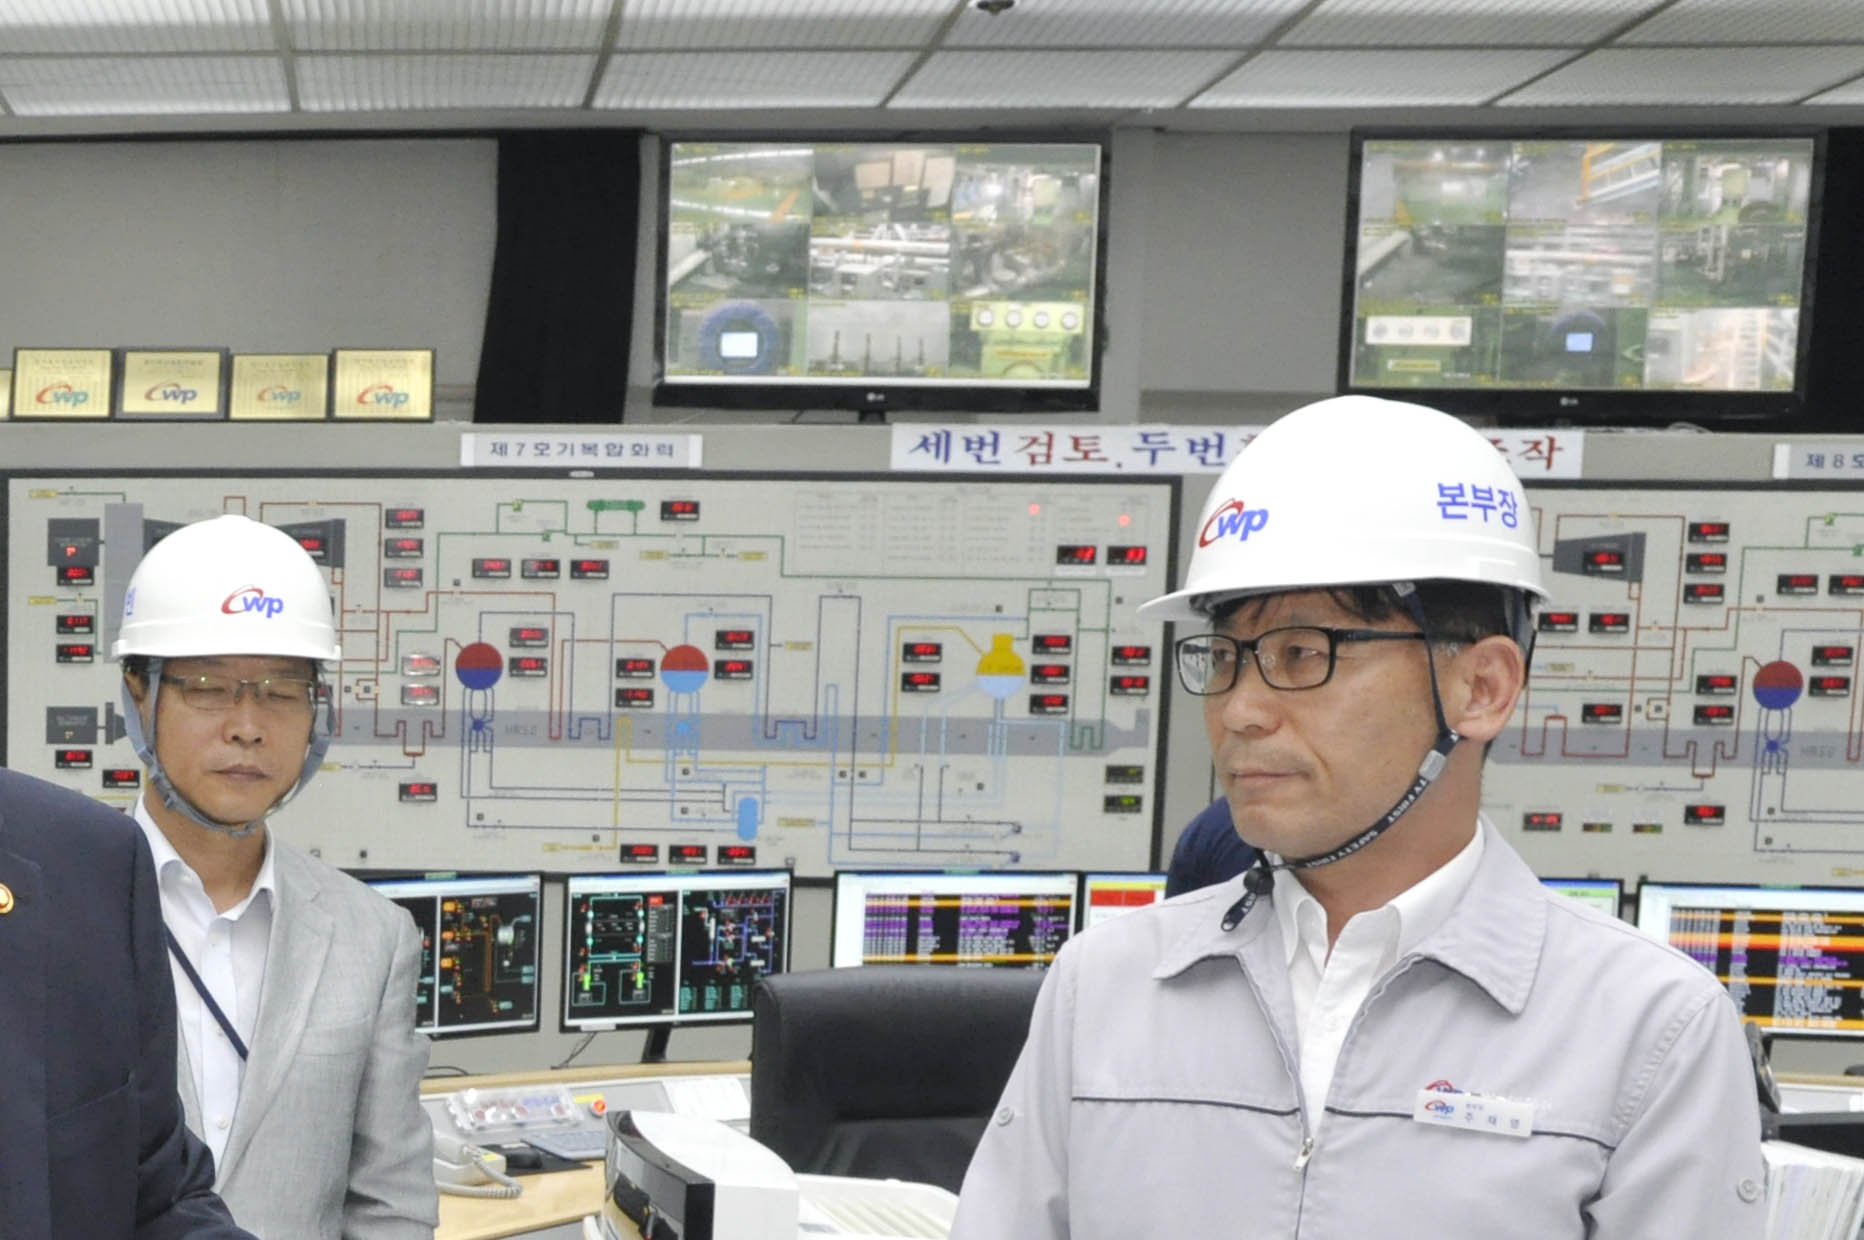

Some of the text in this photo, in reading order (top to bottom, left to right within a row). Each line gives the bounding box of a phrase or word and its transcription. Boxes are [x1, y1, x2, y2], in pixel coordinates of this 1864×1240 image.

[908, 429, 1001, 465] 세번
[1132, 431, 1227, 467] 두번
[1437, 482, 1518, 528] 본부장
